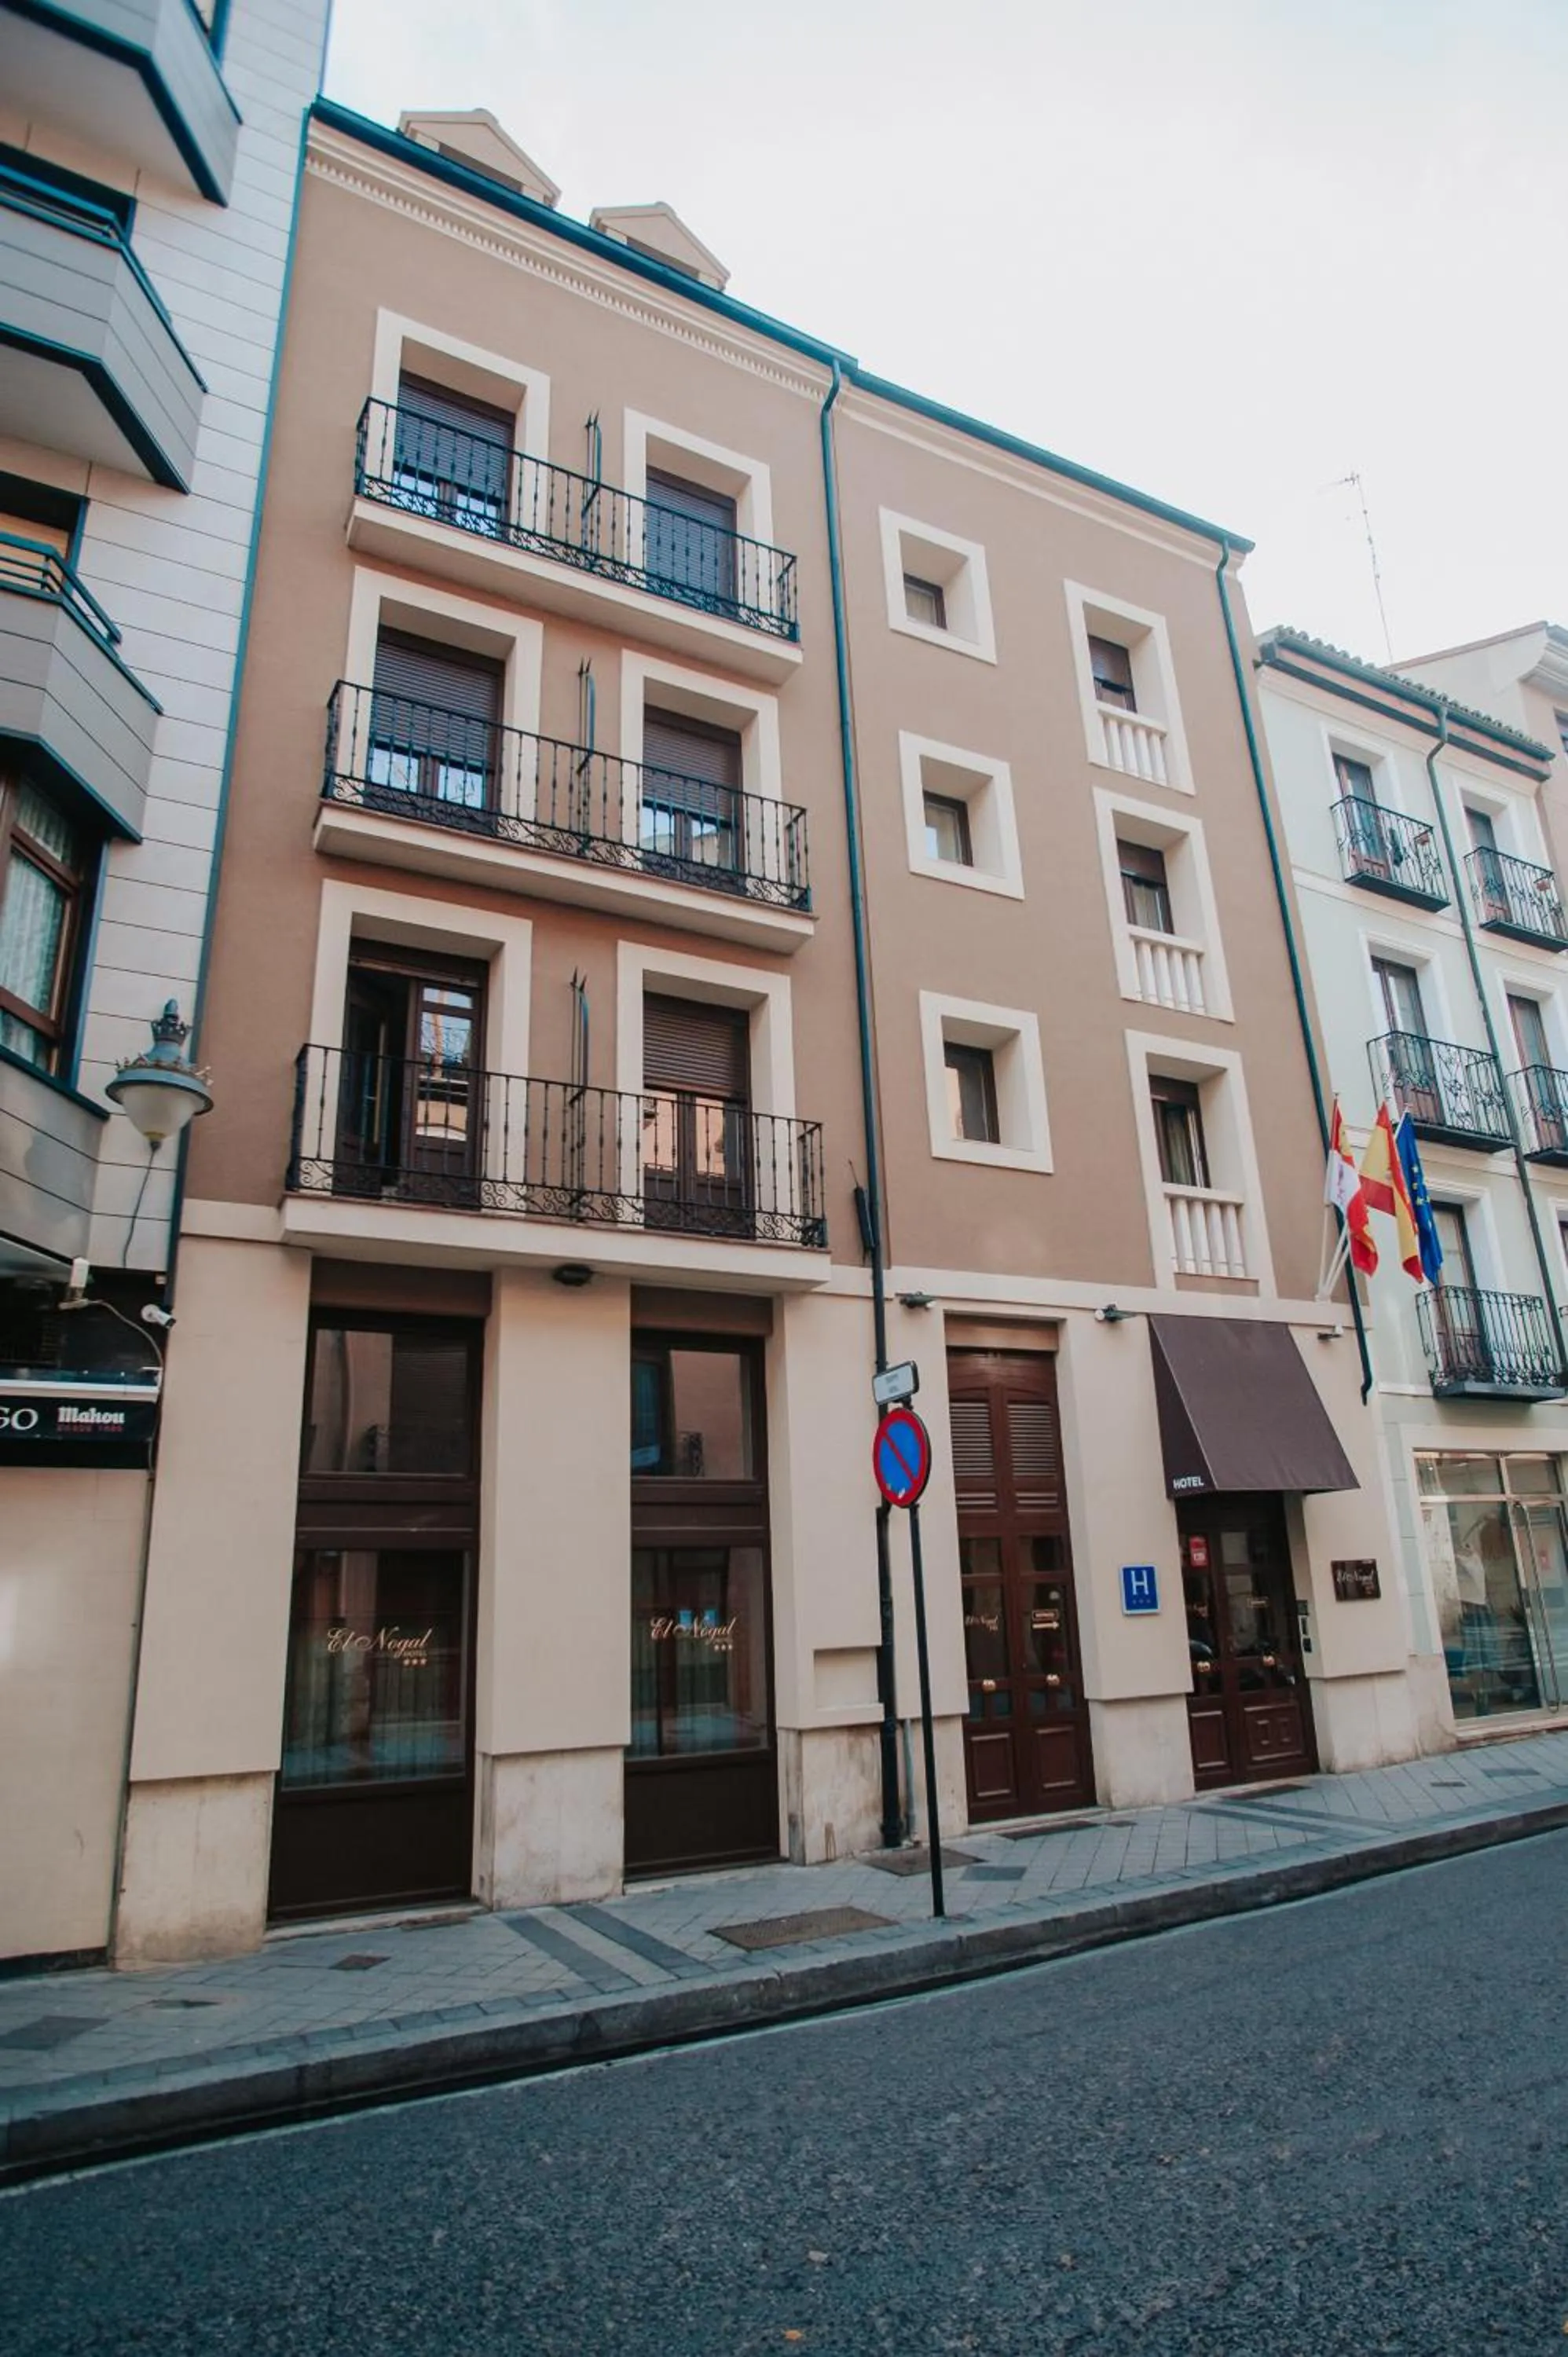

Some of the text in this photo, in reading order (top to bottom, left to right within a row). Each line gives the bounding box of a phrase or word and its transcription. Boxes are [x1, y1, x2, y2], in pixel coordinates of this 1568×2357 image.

[57, 1406, 125, 1424] Mahou
[1173, 1475, 1204, 1490] HOTEL
[1130, 1570, 1149, 1596] H
[650, 1617, 673, 1640] El
[327, 1626, 432, 1659] El Nogal
